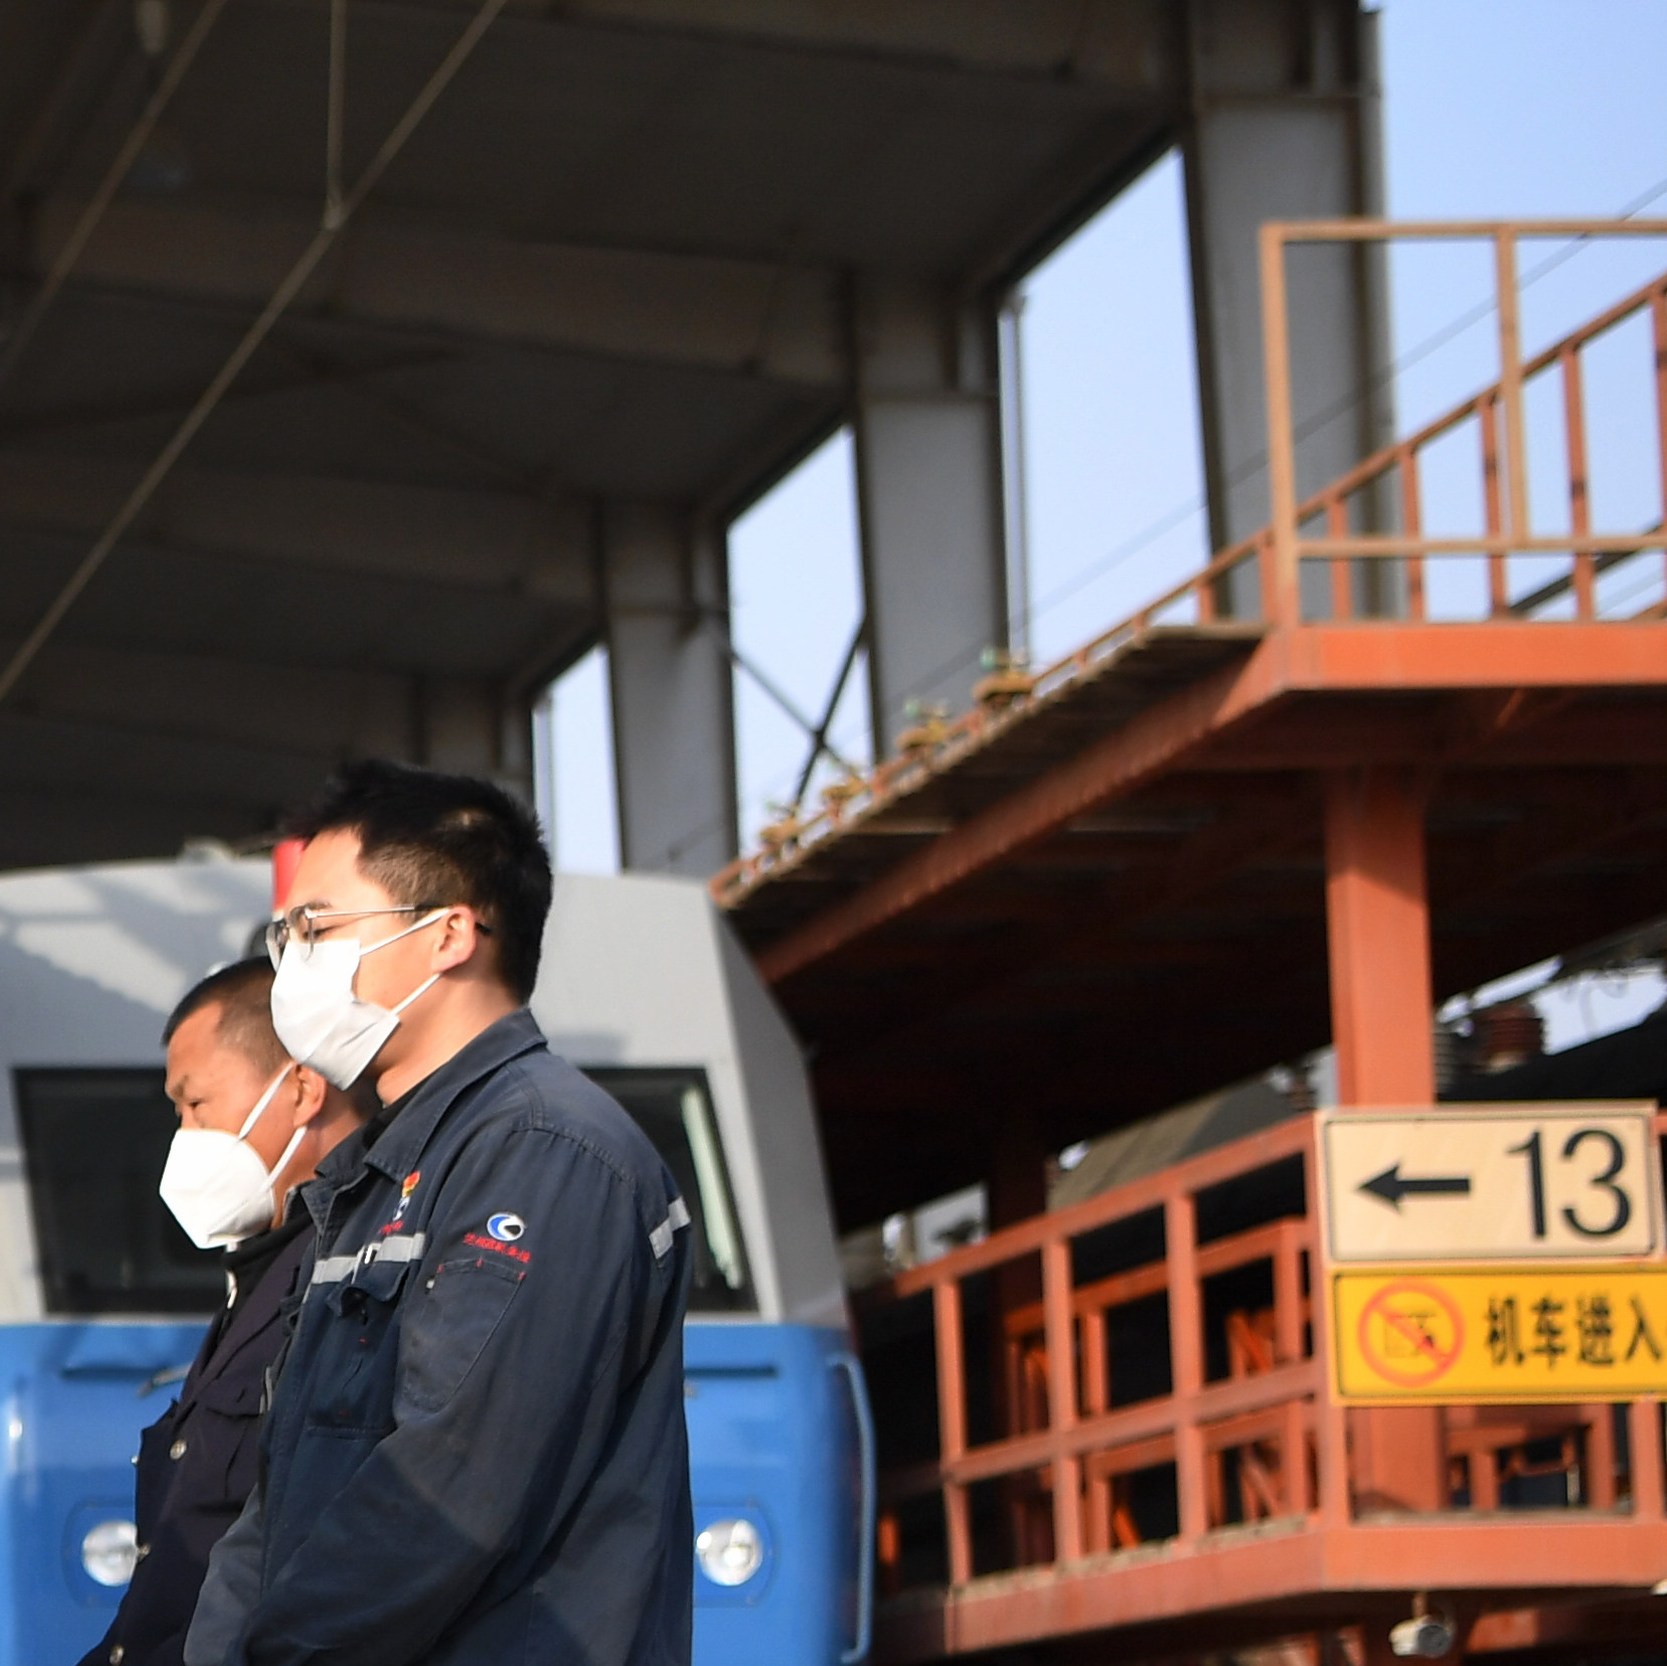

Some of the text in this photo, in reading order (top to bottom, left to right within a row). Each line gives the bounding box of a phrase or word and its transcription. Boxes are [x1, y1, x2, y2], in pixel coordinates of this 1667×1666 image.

[1505, 1128, 1633, 1240] 13
[1486, 1290, 1662, 1368] 机车进入
